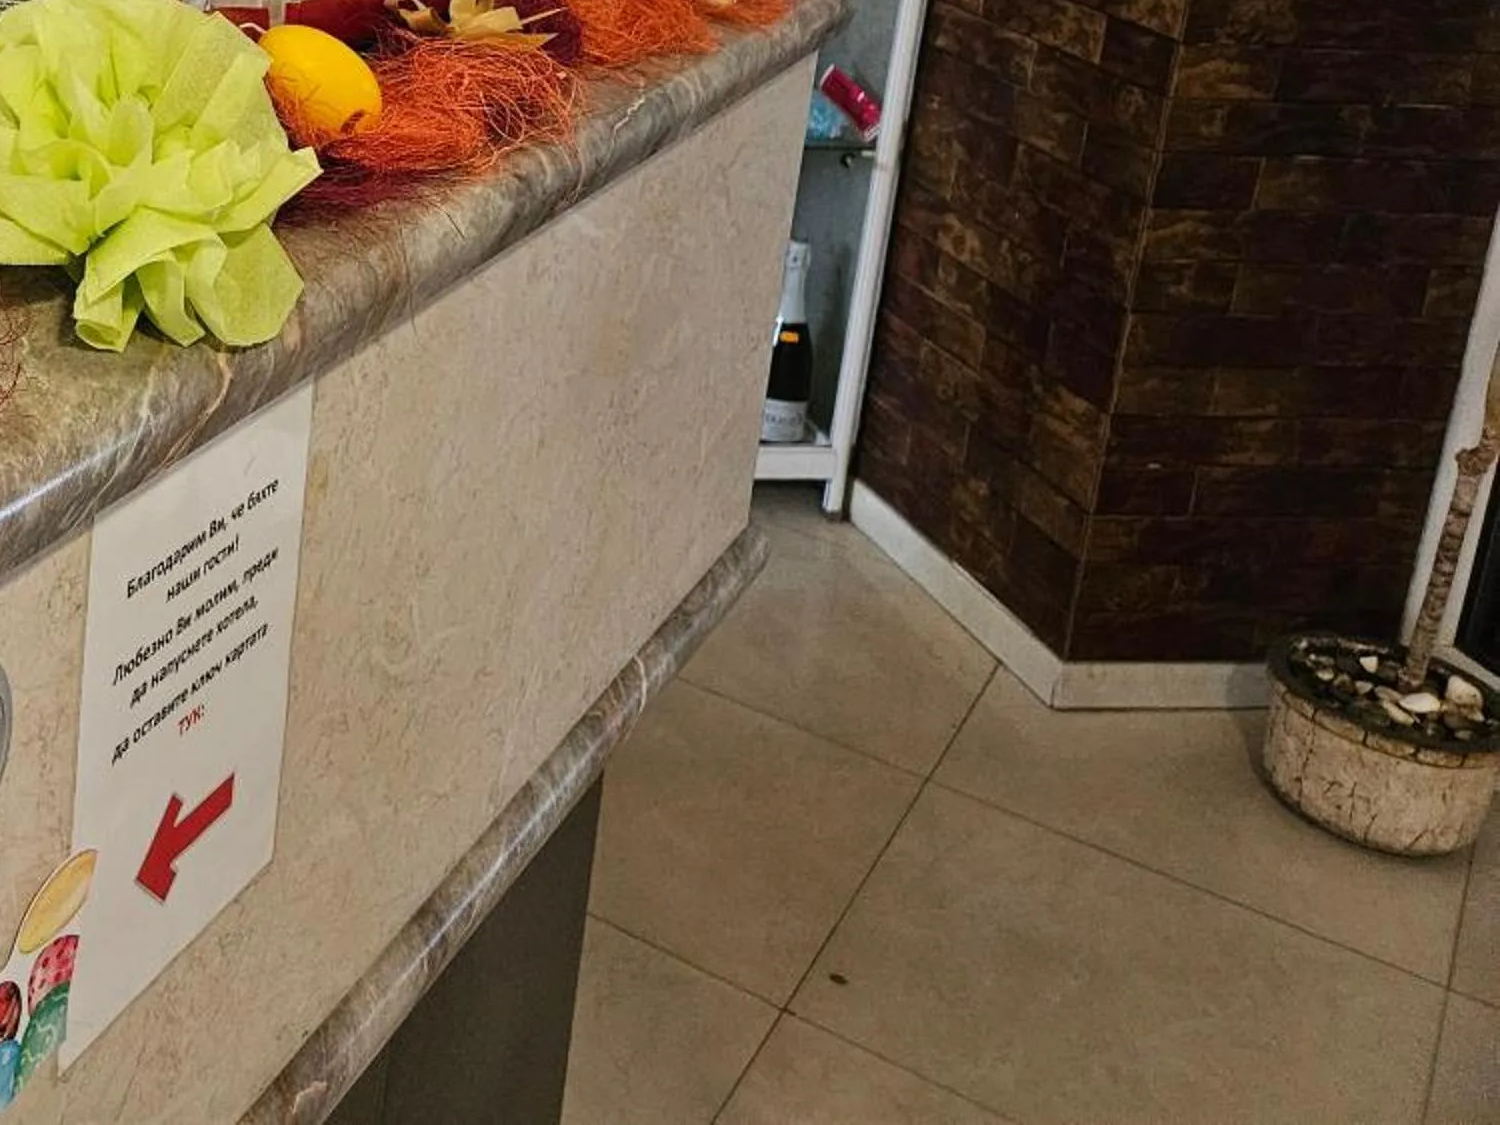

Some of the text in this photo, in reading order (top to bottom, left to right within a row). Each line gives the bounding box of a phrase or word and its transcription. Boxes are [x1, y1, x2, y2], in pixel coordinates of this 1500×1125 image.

[126, 478, 279, 599] Благодарим Ви, че бяхте
[165, 532, 241, 603] наши гости!
[112, 546, 280, 686] Любезно Ви молим, преди
[129, 594, 259, 709] да напуснете хотела,
[111, 622, 270, 767] да оставите ключ картата
[177, 704, 206, 738] ТУК:
